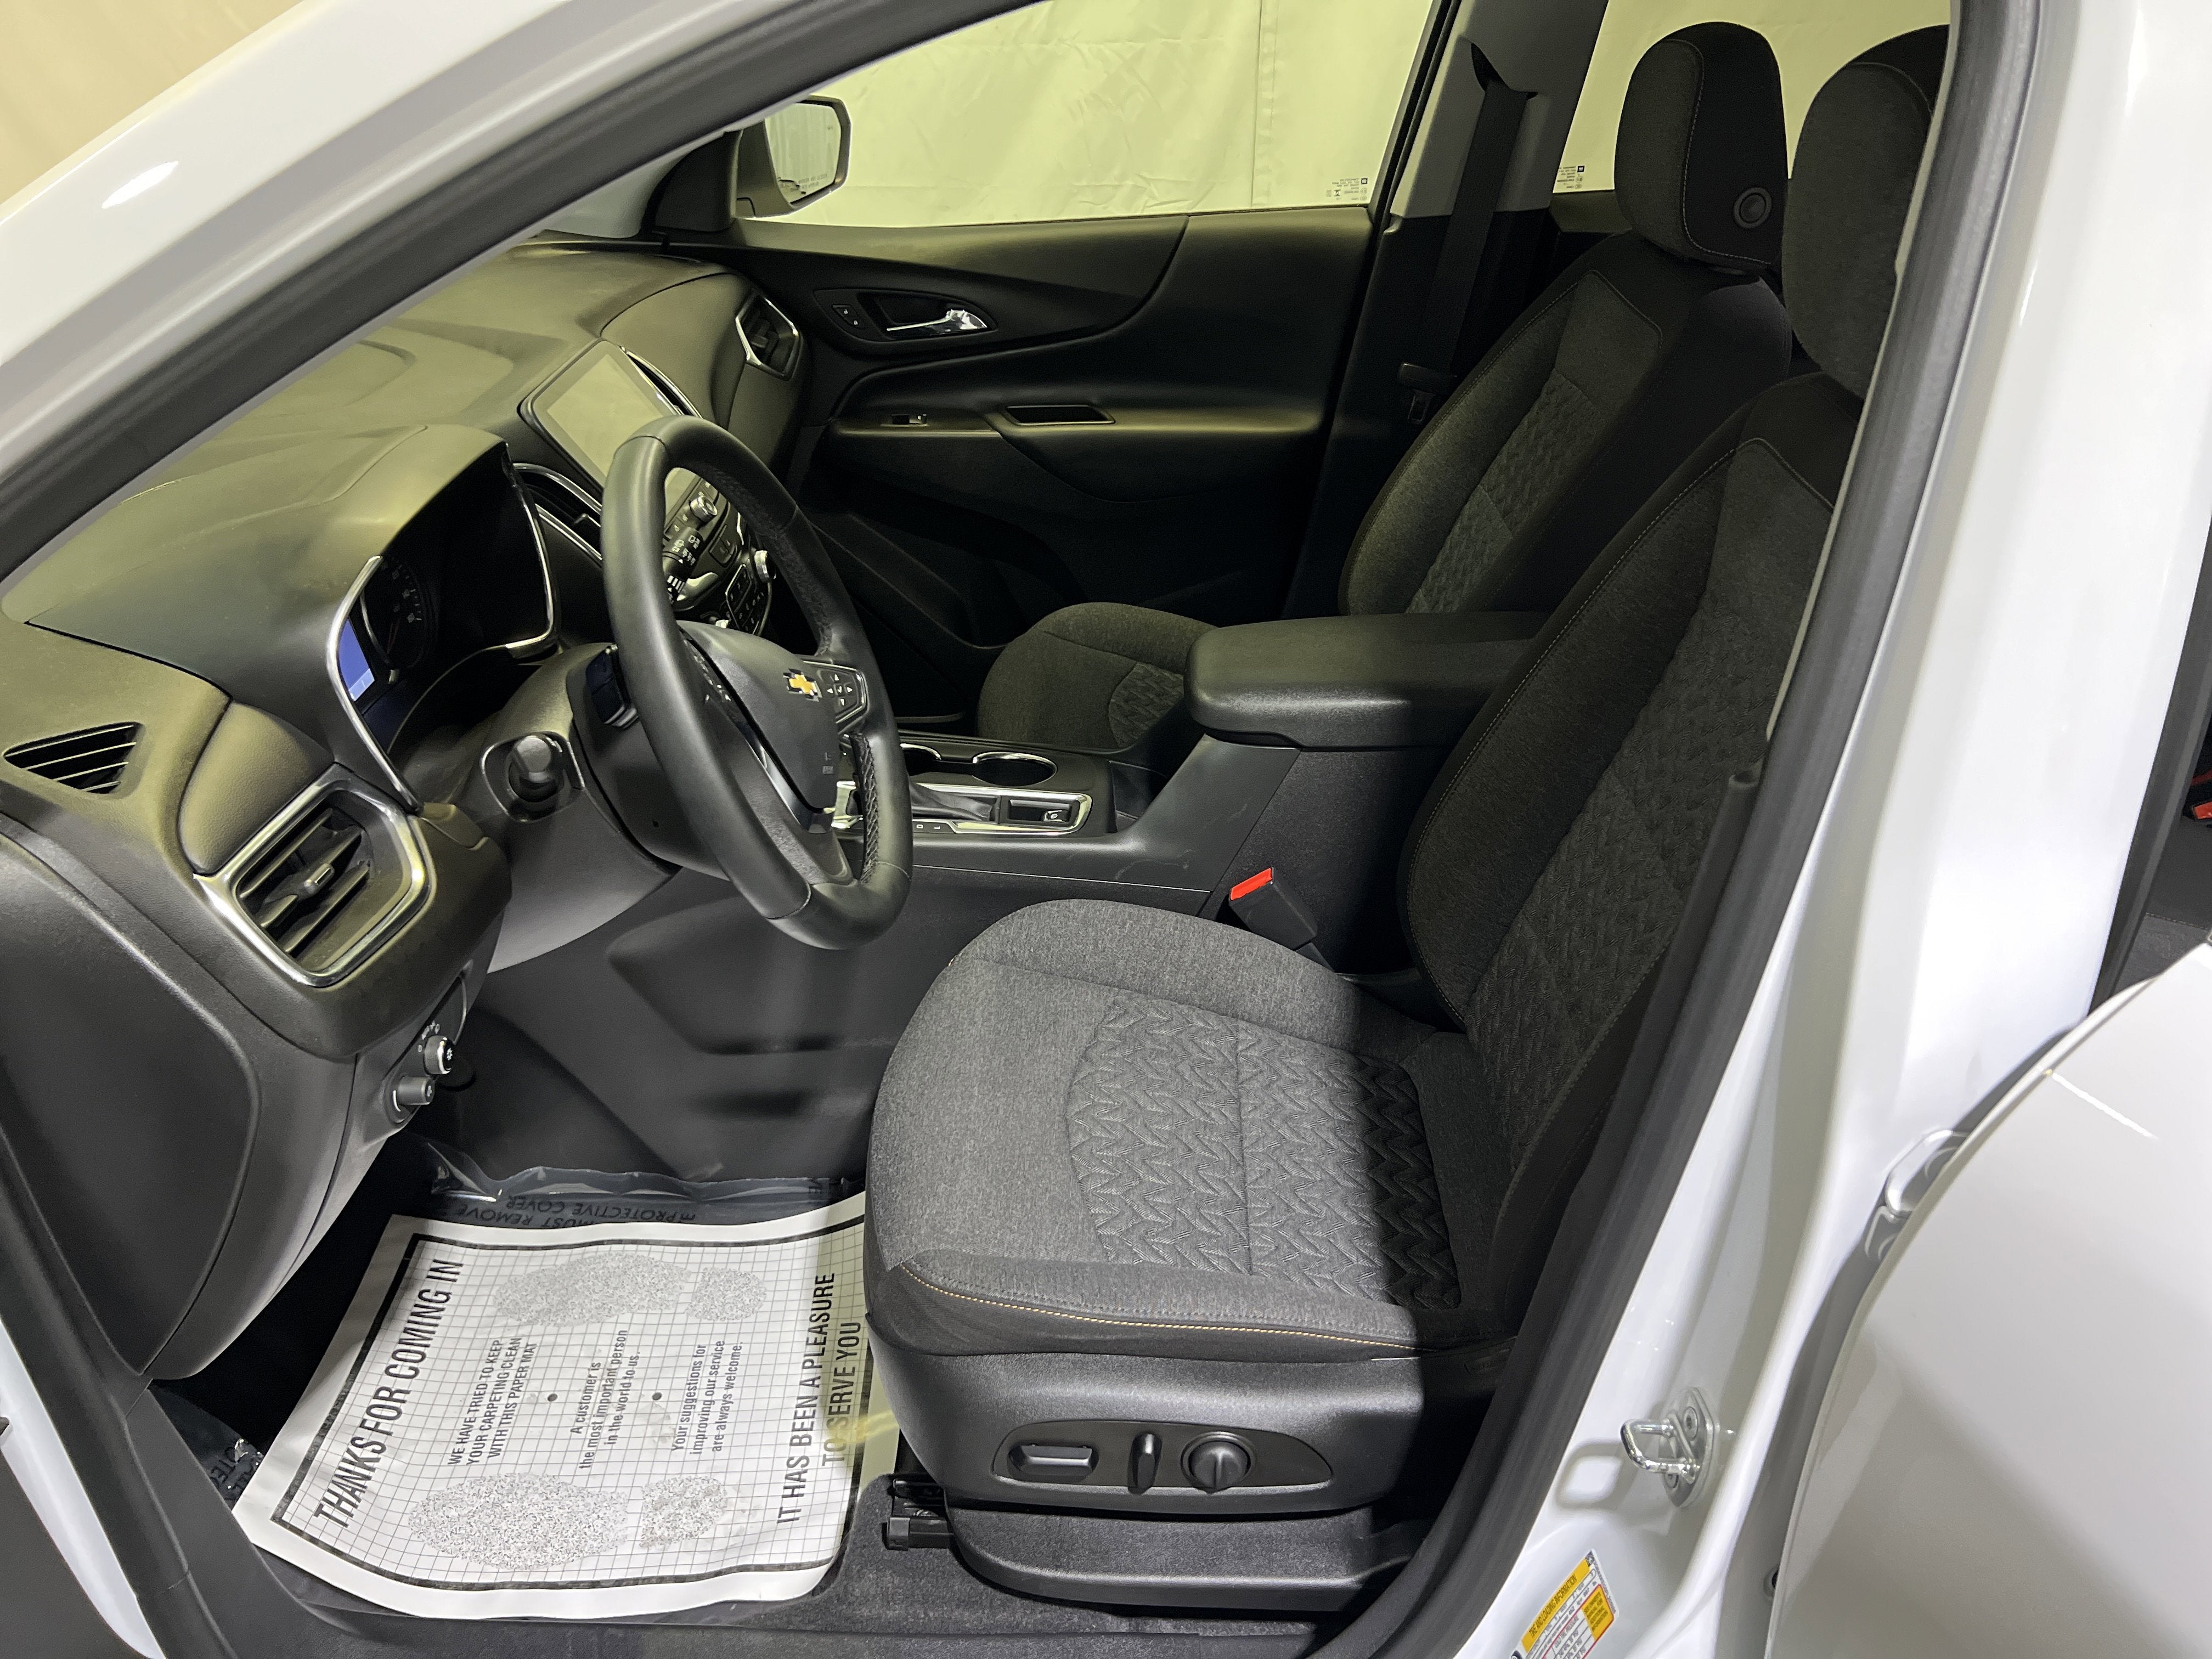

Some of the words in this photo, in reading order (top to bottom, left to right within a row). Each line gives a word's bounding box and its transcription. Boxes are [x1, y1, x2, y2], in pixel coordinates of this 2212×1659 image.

[506, 1195, 565, 1214] COVER
[572, 1203, 678, 1222] PROTECTIVE
[802, 1273, 834, 1369] PLEASURE
[485, 1340, 502, 1364] KEEP
[611, 1330, 628, 1365] person
[836, 1322, 861, 1361] YOU
[479, 1367, 494, 1380] TO
[628, 1351, 641, 1367] us.
[709, 1340, 725, 1376] service
[724, 1341, 743, 1390] welcome.
[623, 1369, 635, 1380] to
[705, 1378, 716, 1396] our
[799, 1375, 821, 1388] A
[314, 1436, 386, 1528] THANKS
[359, 1386, 411, 1436] FOR
[385, 1289, 452, 1379] COMING
[426, 1259, 463, 1282] IN
[466, 1434, 488, 1465] YOUR
[479, 1372, 510, 1431] CARPETING
[501, 1338, 522, 1369] CLEAN
[467, 1383, 488, 1414] TRIED
[488, 1429, 509, 1458] WITH
[499, 1402, 517, 1426] THIS
[509, 1365, 529, 1399] PAPER
[521, 1342, 537, 1363] MAT
[577, 1374, 598, 1423] customer
[588, 1362, 601, 1371] is
[593, 1367, 617, 1417] important
[616, 1381, 632, 1412] world
[671, 1425, 688, 1452] Your
[680, 1361, 703, 1423] suggestions
[693, 1344, 706, 1358] for
[826, 1366, 856, 1430] SERVE
[608, 1415, 623, 1432] the
[690, 1400, 715, 1454] improving
[715, 1393, 734, 1430] always
[789, 1395, 819, 1446] BEEN
[456, 1417, 476, 1444] HAVE
[588, 1421, 603, 1448] most
[604, 1435, 618, 1444] in
[712, 1434, 724, 1452] are
[448, 1447, 465, 1465] WE
[579, 1452, 594, 1469] the
[822, 1438, 847, 1466] TO
[782, 1455, 810, 1498] HAS
[777, 1506, 802, 1524] IT
